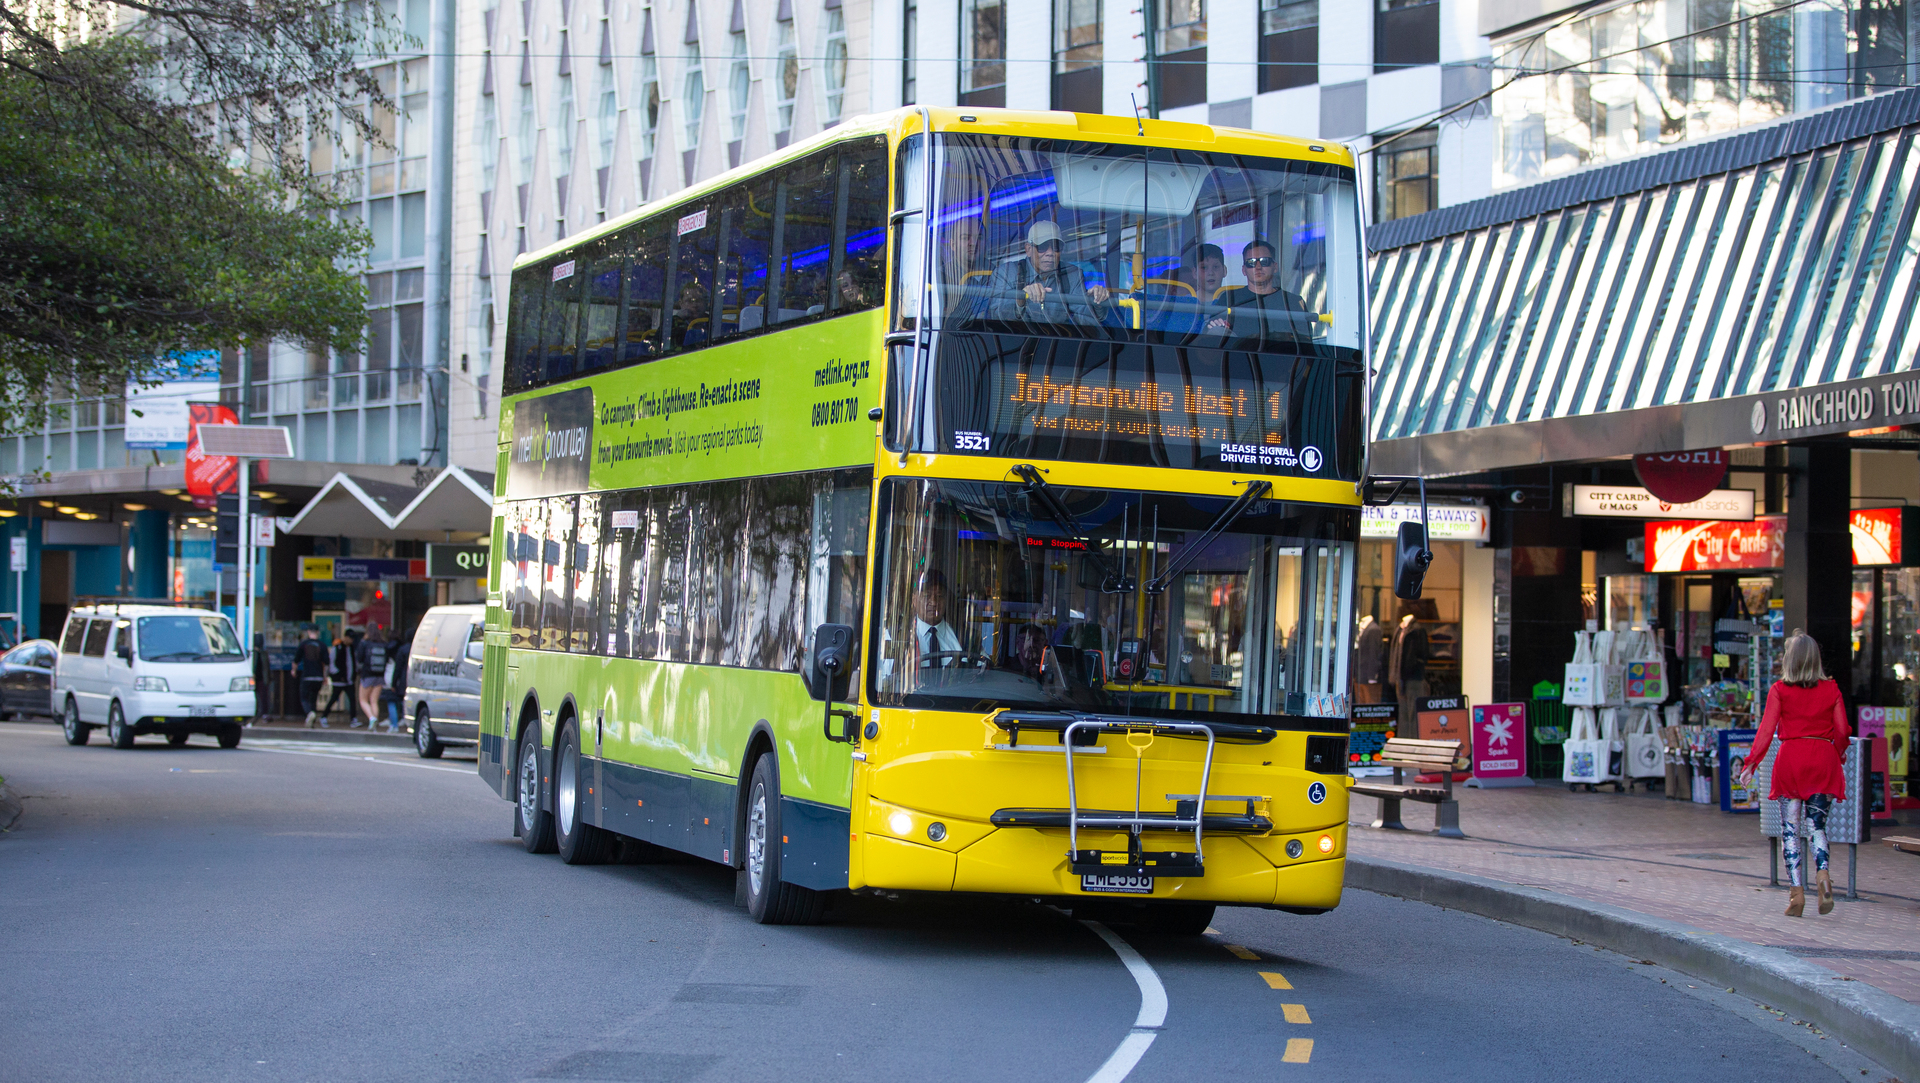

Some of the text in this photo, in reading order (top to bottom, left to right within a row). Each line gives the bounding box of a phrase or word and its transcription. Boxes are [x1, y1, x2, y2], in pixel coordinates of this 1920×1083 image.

[814, 358, 870, 388] metlink.org.nz
[601, 377, 761, 429] Go camping. Climb a lighthouse. Re-enact a scene
[1010, 373, 1280, 419] Johnsonville West 1
[811, 396, 858, 427] 0800 801 700
[1777, 386, 1874, 431] RANCHHOD
[517, 426, 545, 463] metlink
[556, 428, 570, 458] our
[570, 426, 588, 462] way
[598, 418, 764, 469] from your favourite movie. Visit your regional parks today.
[954, 435, 990, 451] 3521
[1221, 443, 1295, 457] PLEASE SIGNAL
[1220, 453, 1298, 467] DRIVER TO STOP
[1589, 492, 1650, 502] CITY CARDS
[1599, 501, 1638, 512] & MAGS
[1705, 499, 1740, 512] sands
[1390, 508, 1398, 520] &
[1405, 507, 1478, 523] TAEAWAYS
[1374, 520, 1396, 528] WITH
[1449, 522, 1471, 532] FOOD
[1027, 537, 1088, 551] Bus Stopping
[1694, 529, 1724, 563] City
[1727, 527, 1769, 563] Cards
[1427, 698, 1458, 709] OPEN
[1860, 707, 1907, 722] OPEN
[1488, 747, 1509, 757] Spark
[1482, 760, 1517, 769] SOLD HERE
[1101, 854, 1128, 862] sportworks
